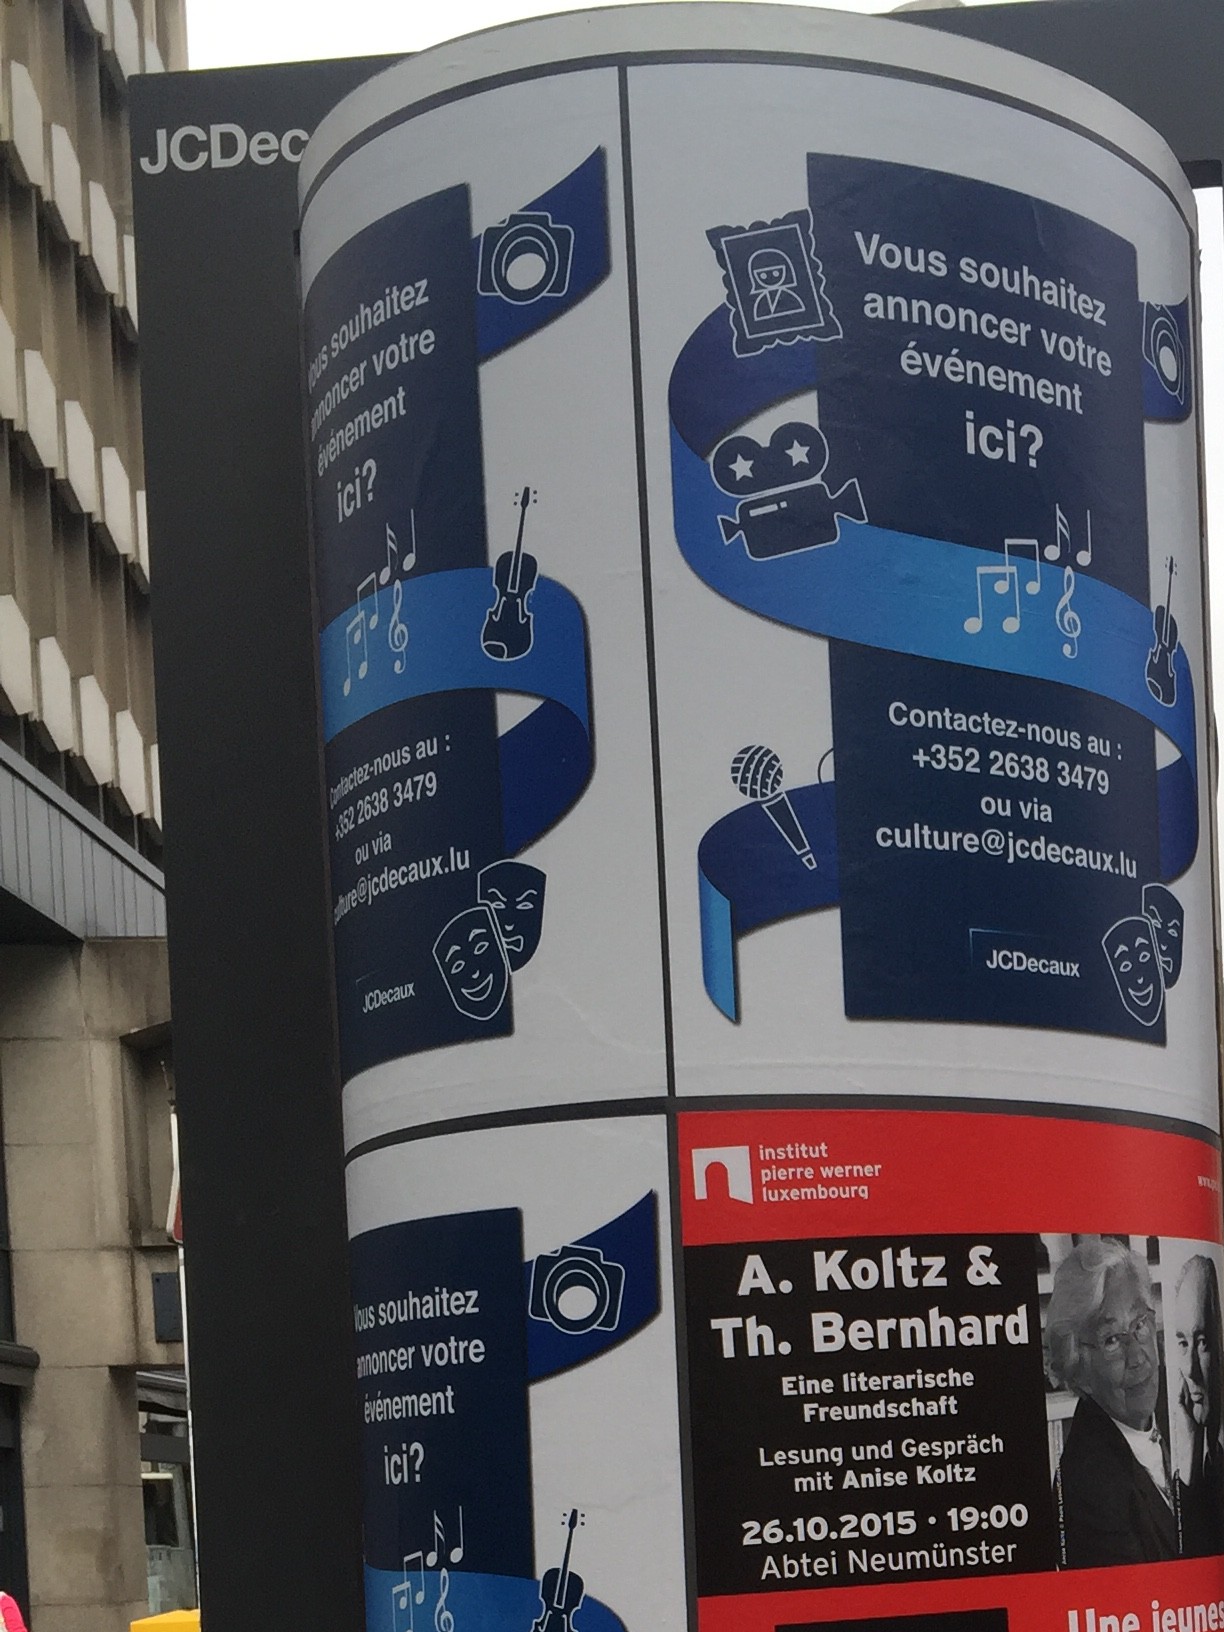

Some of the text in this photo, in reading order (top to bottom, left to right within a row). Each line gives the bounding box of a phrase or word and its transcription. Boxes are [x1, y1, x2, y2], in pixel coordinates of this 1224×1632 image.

[855, 231, 1106, 326] Vous souhaitez
[372, 329, 435, 377] votre
[864, 292, 1112, 376] annoncer votre
[901, 341, 1083, 414] événement
[965, 411, 1043, 468] ici?
[889, 702, 1111, 758] Contactez-nous au
[913, 744, 1109, 795] +352 2638 3479
[981, 795, 1052, 823] ou via
[356, 831, 392, 865] ou via
[876, 824, 1137, 879] culture@jcdecaux.lu
[987, 951, 1080, 978] JCDecaux
[759, 1142, 828, 1161] institut
[762, 1162, 881, 1184] pierre werner
[762, 1183, 868, 1202] luxembourg
[814, 1245, 1002, 1290] Koltz &
[378, 1287, 479, 1326] souhaitez
[711, 1304, 1029, 1358] Th. Bernhard
[421, 1336, 485, 1367] votre
[781, 1368, 974, 1396] Eine literarische
[803, 1396, 958, 1424] Freundschaft
[384, 1442, 424, 1485] ici?
[759, 1434, 1004, 1467] Lesung und Gespräch
[795, 1463, 976, 1493] mit Anise Koltz
[742, 1503, 1029, 1545] 26.10.2015 19:00
[761, 1541, 1017, 1580] Abtei Neumünster
